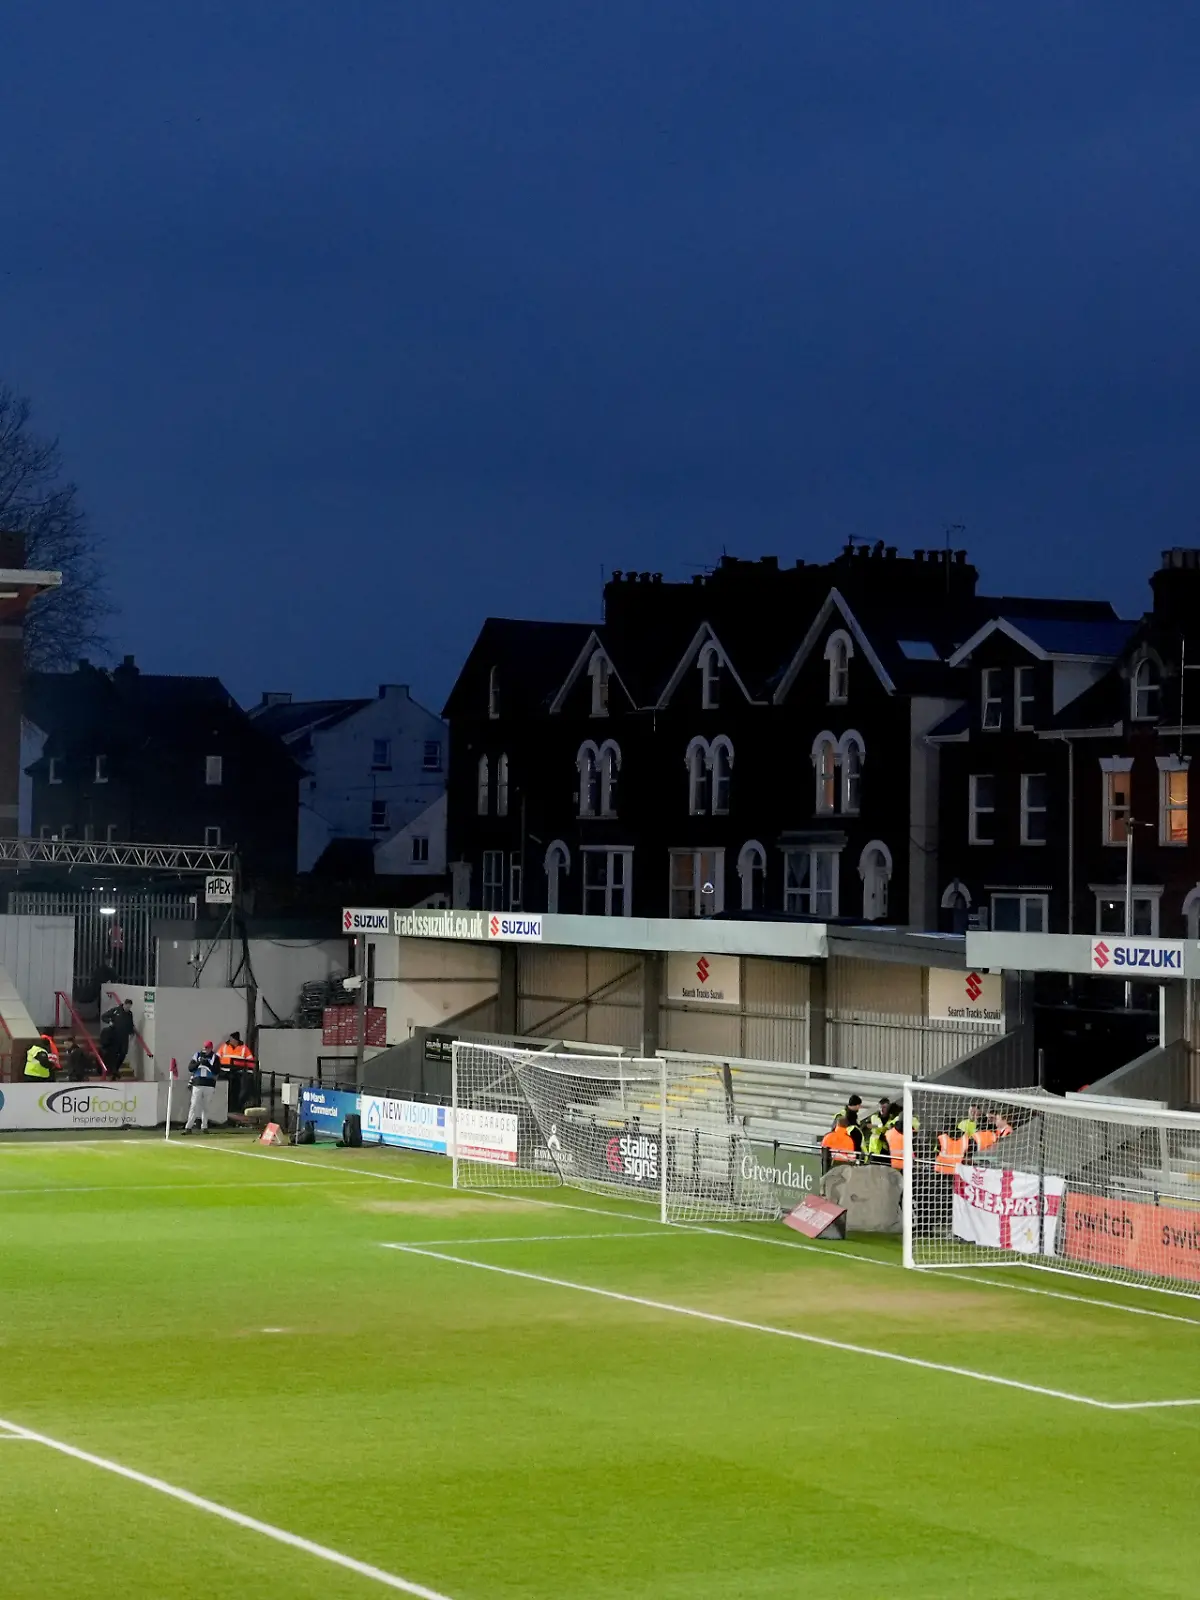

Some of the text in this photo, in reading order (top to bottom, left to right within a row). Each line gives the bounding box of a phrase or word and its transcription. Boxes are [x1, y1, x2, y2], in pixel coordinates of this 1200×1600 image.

[207, 878, 231, 895] APEX
[353, 914, 388, 929] SUZUKI
[393, 910, 483, 938] trackssuzuki.co.uk
[501, 920, 541, 935] SUZUKI
[1113, 947, 1182, 968] SUZUKI
[948, 1006, 1001, 1019] Search Tracks Suzuki
[61, 1096, 137, 1113] Bidfood
[310, 1092, 326, 1104] Marsh
[310, 1103, 338, 1117] Commercial
[382, 1101, 401, 1120] NEW
[404, 1105, 434, 1125] VISION
[72, 1115, 136, 1124] Inspired by you
[620, 1135, 657, 1160] stalite
[624, 1157, 657, 1181] signs
[741, 1155, 813, 1190] Greendale
[1074, 1208, 1134, 1240] switch
